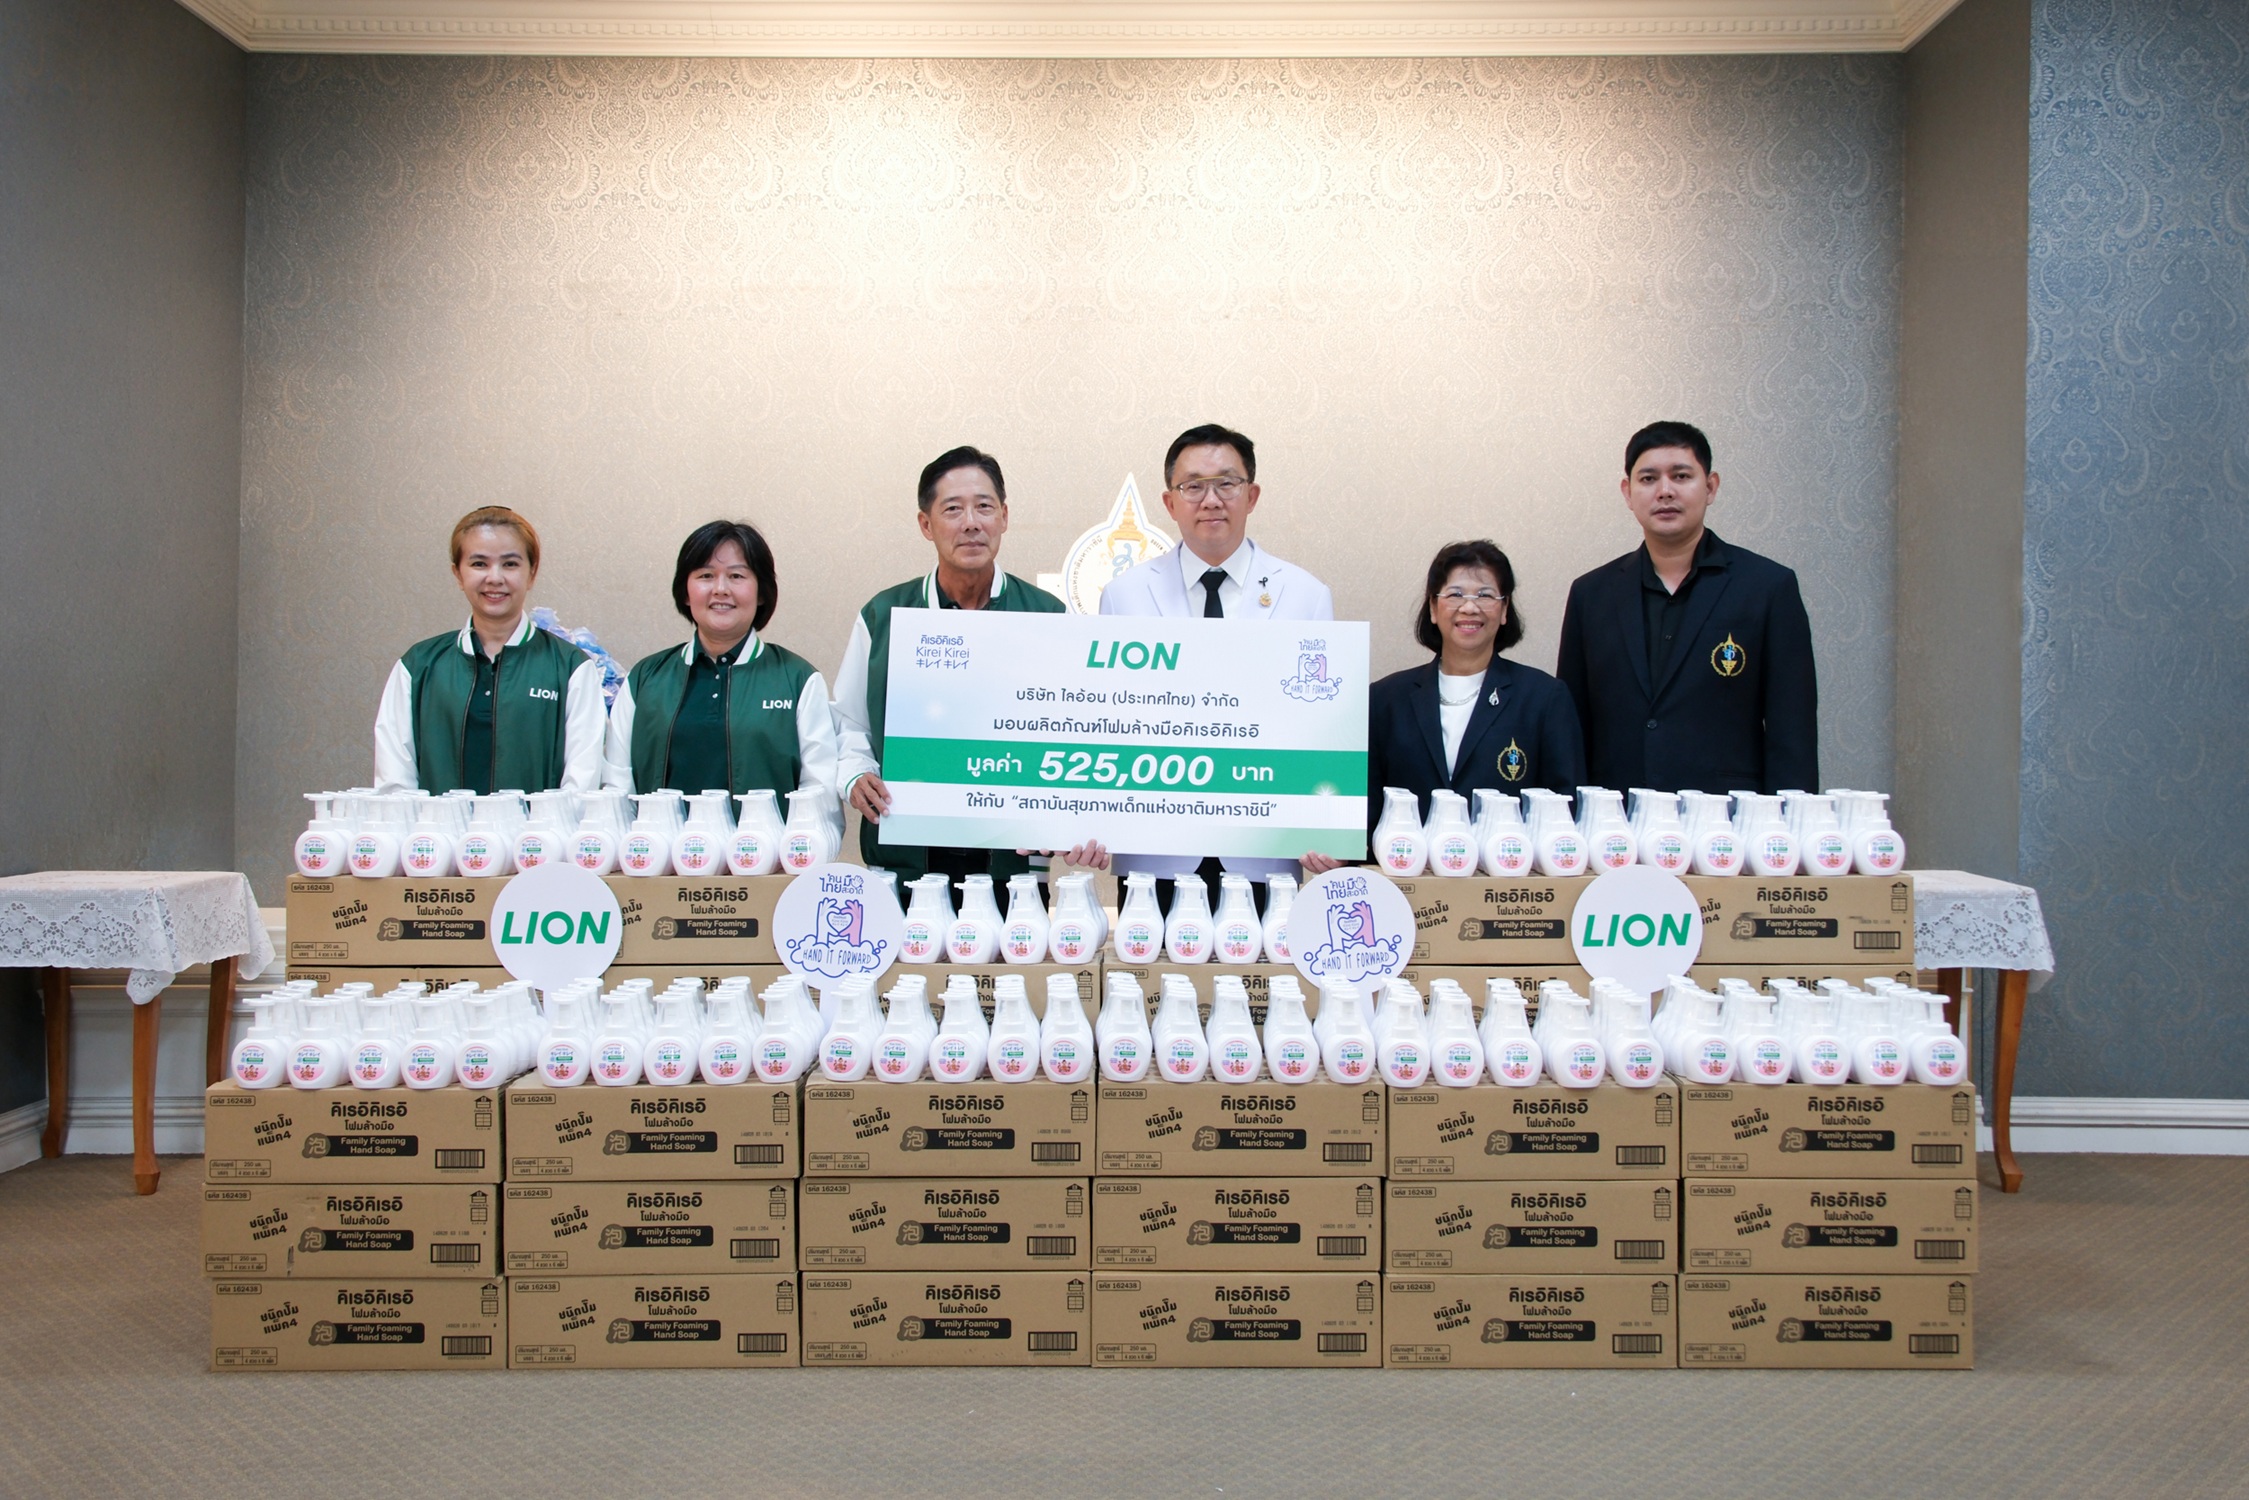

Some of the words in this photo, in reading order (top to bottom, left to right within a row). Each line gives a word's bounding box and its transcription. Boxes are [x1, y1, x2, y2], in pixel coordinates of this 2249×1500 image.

[921, 635, 964, 646] คิเรอิคิเรอิ
[916, 646, 941, 657] Kirei
[945, 648, 970, 658] Kirei
[1086, 640, 1181, 670] LION
[916, 658, 941, 669] キレイ
[944, 659, 969, 670] キレイ
[530, 687, 558, 702] LION
[1016, 688, 1056, 702] บริษัท
[1061, 688, 1107, 703] ไลอ้อน
[1112, 690, 1196, 708] (ประเทศไทย)
[1201, 692, 1239, 708] จำกัด
[762, 699, 792, 710] LION
[994, 716, 1260, 738] มอบผลิตภัณฑ์โฟมล้างมือคิเรอิคิเรอิ
[966, 752, 1022, 777] มูลค่า
[1038, 750, 1214, 787] 525,000
[1232, 764, 1274, 782] บาท
[966, 792, 1005, 809] ให้กับ
[819, 877, 842, 893] ไทย
[404, 889, 475, 903] คิเรอิคิเรอิ
[678, 887, 748, 902] คิเรอิคิเรอิ
[1322, 886, 1346, 900] ไทย
[1484, 889, 1555, 903] คิเรอิคิเรอิ
[1757, 887, 1828, 901] คิเรอิคิเรอิ
[417, 905, 463, 916] โฟมล้างมือ
[690, 904, 736, 915] โฟมล้างมือ
[1497, 905, 1543, 916] โฟมล้างมือ
[440, 922, 473, 930] Foaming
[501, 911, 611, 945] LION
[687, 920, 712, 928] Family
[714, 920, 747, 928] Foaming
[1493, 921, 1518, 929] Family
[1520, 921, 1553, 929] Foaming
[1582, 913, 1692, 947] LION
[1766, 920, 1791, 928] Family
[1793, 920, 1826, 928] Foaming
[443, 930, 465, 938] Soap
[717, 929, 738, 937] Soap
[1523, 930, 1545, 938] Soap
[1796, 929, 1818, 937] Soap
[803, 949, 822, 963] HAND
[826, 949, 834, 964] IT
[837, 950, 871, 965] FORWARD
[1322, 956, 1341, 970] HAND
[1345, 954, 1352, 969] IT
[1356, 952, 1390, 968] FORWARD
[630, 1098, 707, 1114] คิเรอิคิเรอิ
[928, 1095, 1005, 1110] คิเรอิคิเรอิ
[1220, 1096, 1296, 1110] คิเรอิคิเรอิ
[1512, 1099, 1589, 1114] คิเรอิคิเรอิ
[331, 1102, 408, 1117] คิเรอิคิเรอิ
[644, 1116, 694, 1128] โฟมล้างมือ
[942, 1113, 991, 1124] โฟมล้างมือ
[1234, 1113, 1283, 1125] โฟมล้างมือ
[344, 1119, 394, 1131] โฟมล้างมือ
[640, 1134, 667, 1142] Family
[669, 1133, 705, 1143] Foaming
[1230, 1130, 1257, 1139] Family
[1259, 1130, 1294, 1139] Foaming
[1522, 1134, 1549, 1143] Family
[1551, 1134, 1587, 1143] Foaming
[673, 1143, 696, 1152] Soap
[1262, 1140, 1285, 1148] Soap
[1532, 1143, 1553, 1151] Hand
[1554, 1143, 1577, 1152] Soap
[626, 1192, 703, 1208] คิเรอิคิเรอิ
[924, 1190, 1000, 1205] คิเรอิคิเรอิ
[1214, 1190, 1290, 1205] คิเรอิคิเรอิ
[1510, 1193, 1587, 1208] คิเรอิคิเรอิ
[326, 1197, 403, 1211] คิเรอิคิเรอิ
[640, 1210, 690, 1222] โฟมล้างมือ
[938, 1207, 987, 1219] โฟมล้างมือ
[1228, 1207, 1277, 1219] โฟมล้างมือ
[1524, 1211, 1574, 1222] โฟมล้างมือ
[340, 1214, 390, 1226] โฟมล้างมือ
[934, 1225, 960, 1233] Family
[962, 1224, 998, 1233] Foaming
[966, 1234, 989, 1242] Soap
[337, 1290, 414, 1305] คิเรอิคิเรอิ
[634, 1287, 710, 1302] คิเรอิคิเรอิ
[925, 1285, 1001, 1300] คิเรอิคิเรอิ
[1215, 1286, 1290, 1301] คิเรอิคิเรอิ
[1509, 1287, 1585, 1302] คิเรอิคิเรอิ
[351, 1307, 401, 1319] โฟมล้างมือ
[648, 1304, 697, 1316] โฟมล้างมือ
[939, 1302, 988, 1314] โฟมล้างมือ
[1228, 1304, 1277, 1316] โฟมล้างมือ
[1522, 1305, 1572, 1317] โฟมล้างมือ
[347, 1325, 374, 1333] Family
[376, 1324, 412, 1333] Foaming
[1224, 1321, 1251, 1330] Family
[1253, 1321, 1288, 1330] Foaming
[379, 1334, 403, 1343] Soap
[1256, 1331, 1279, 1339] Soap
